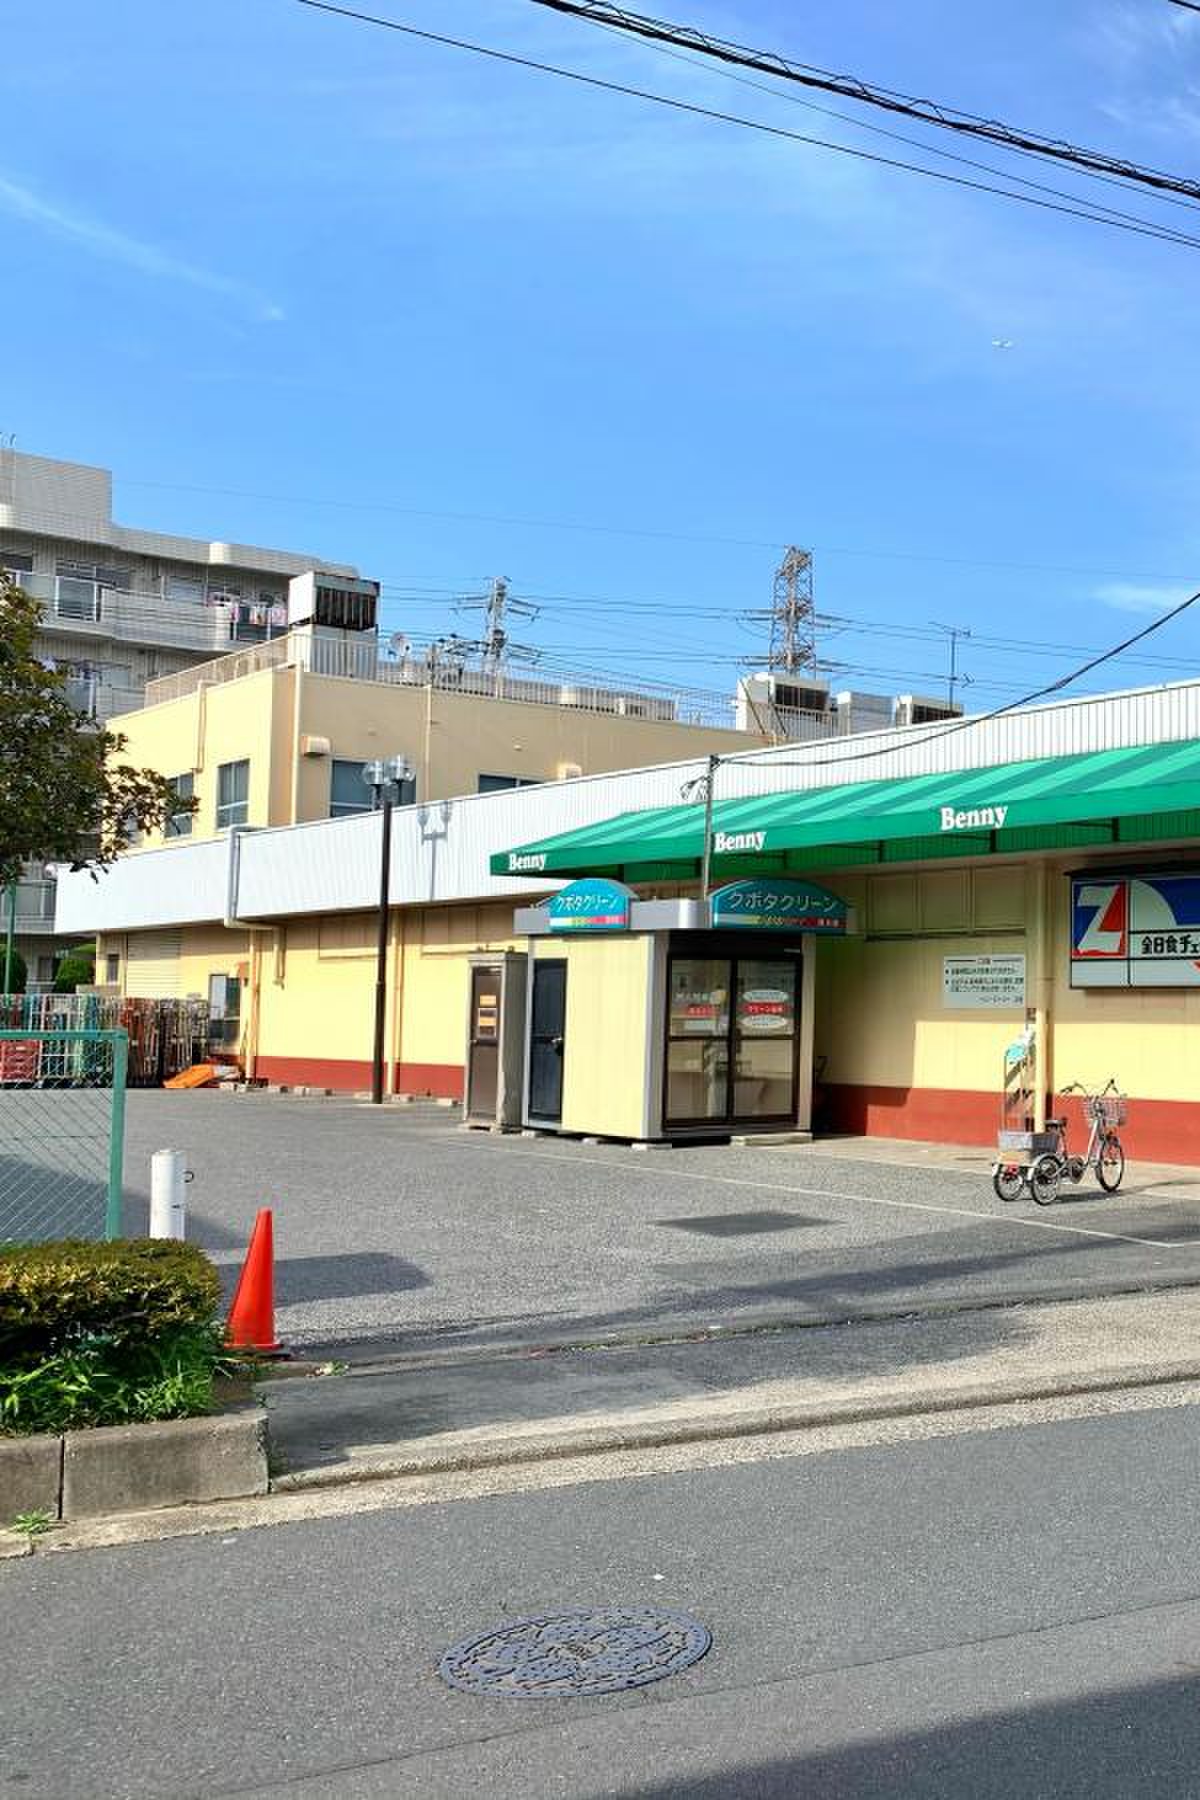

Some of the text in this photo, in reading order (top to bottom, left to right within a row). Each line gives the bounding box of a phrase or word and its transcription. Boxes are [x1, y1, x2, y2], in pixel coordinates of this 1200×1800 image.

[941, 805, 1009, 831] Benny
[714, 831, 767, 853] Benny
[509, 853, 547, 871] Benny
[555, 894, 619, 913] クボタクリーン
[728, 891, 838, 912] クボタクリーン
